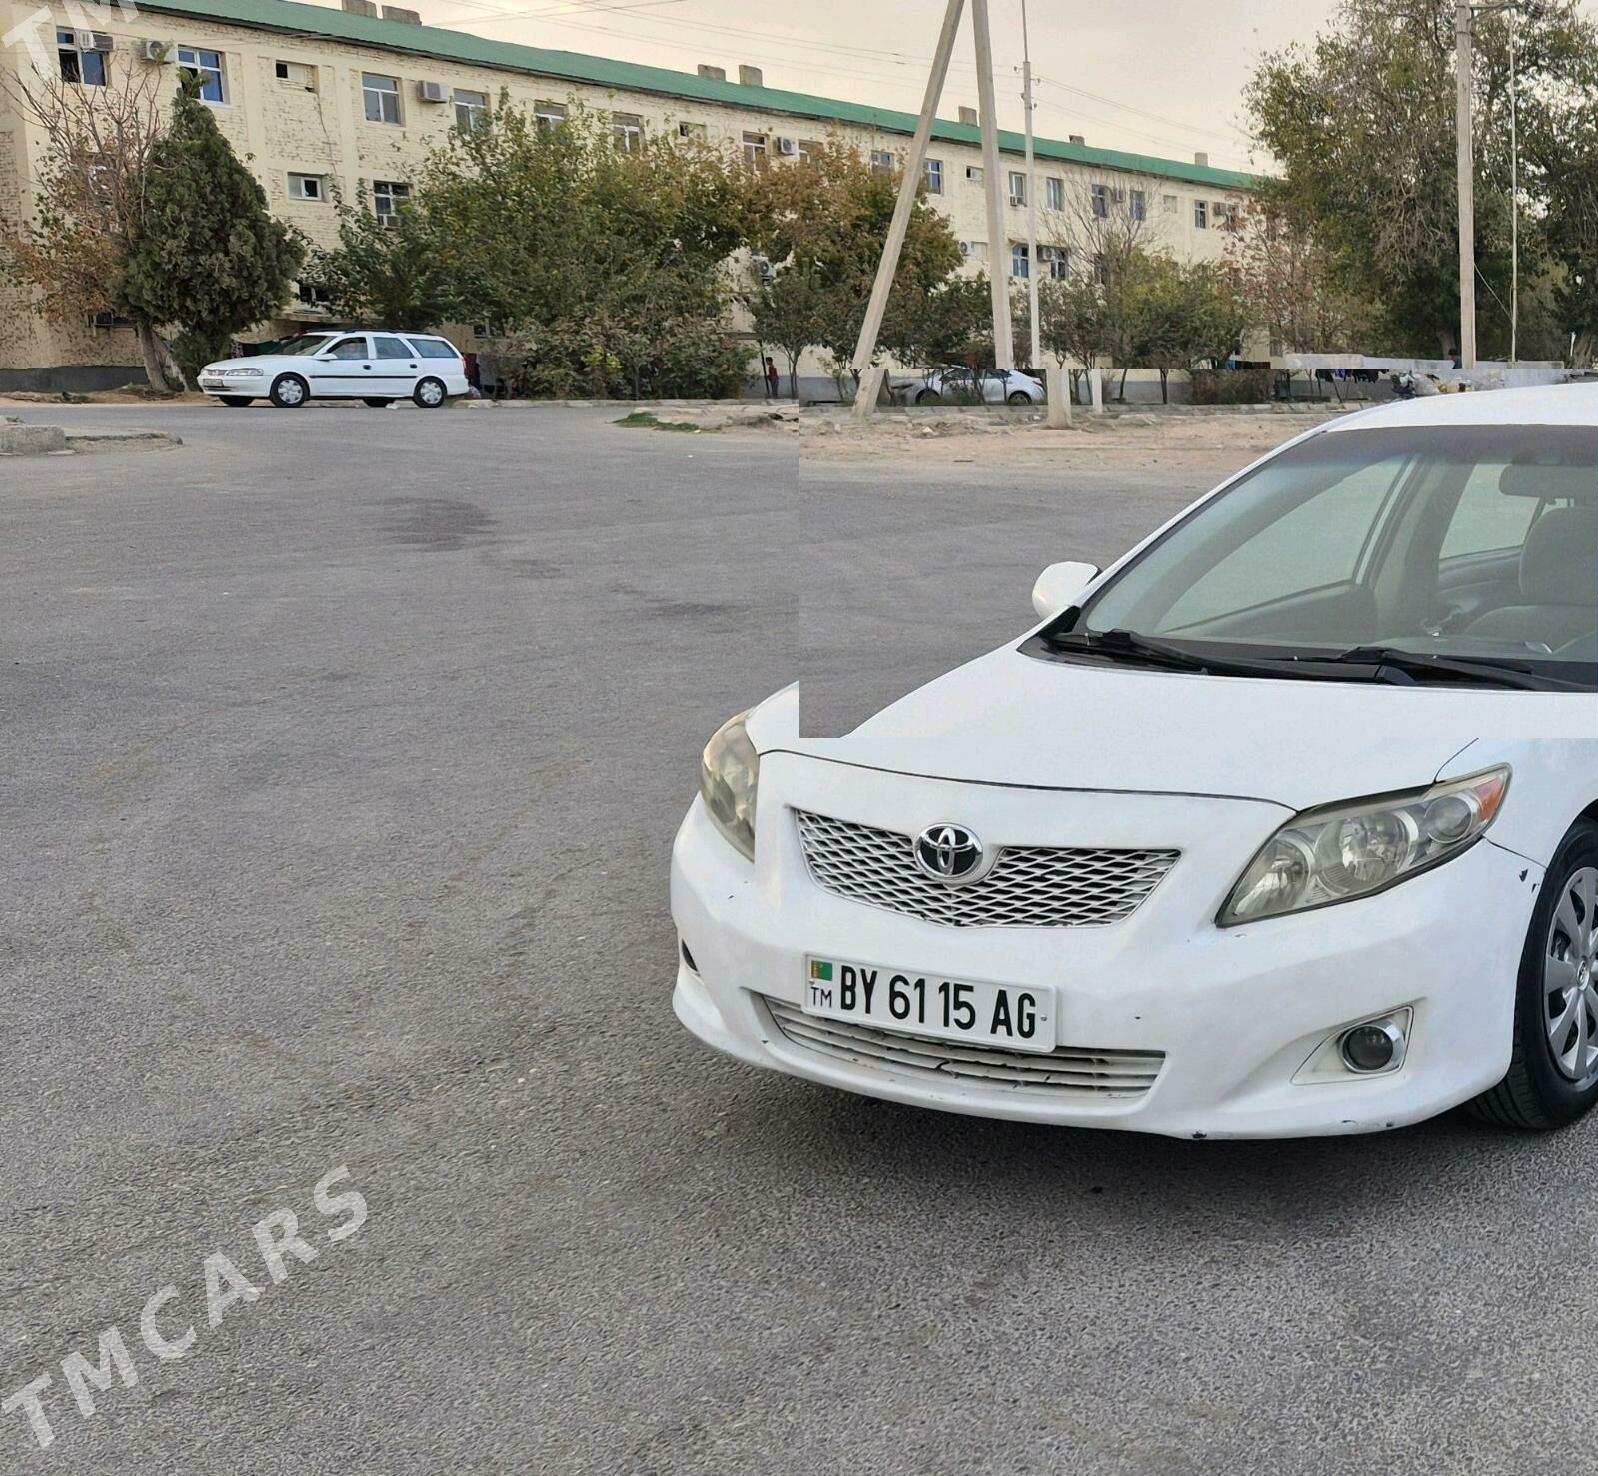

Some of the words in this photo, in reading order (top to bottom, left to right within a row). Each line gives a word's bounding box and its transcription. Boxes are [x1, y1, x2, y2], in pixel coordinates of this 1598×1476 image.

[810, 986, 833, 1009] TM
[840, 964, 878, 1014] BY
[990, 988, 1036, 1039] AG
